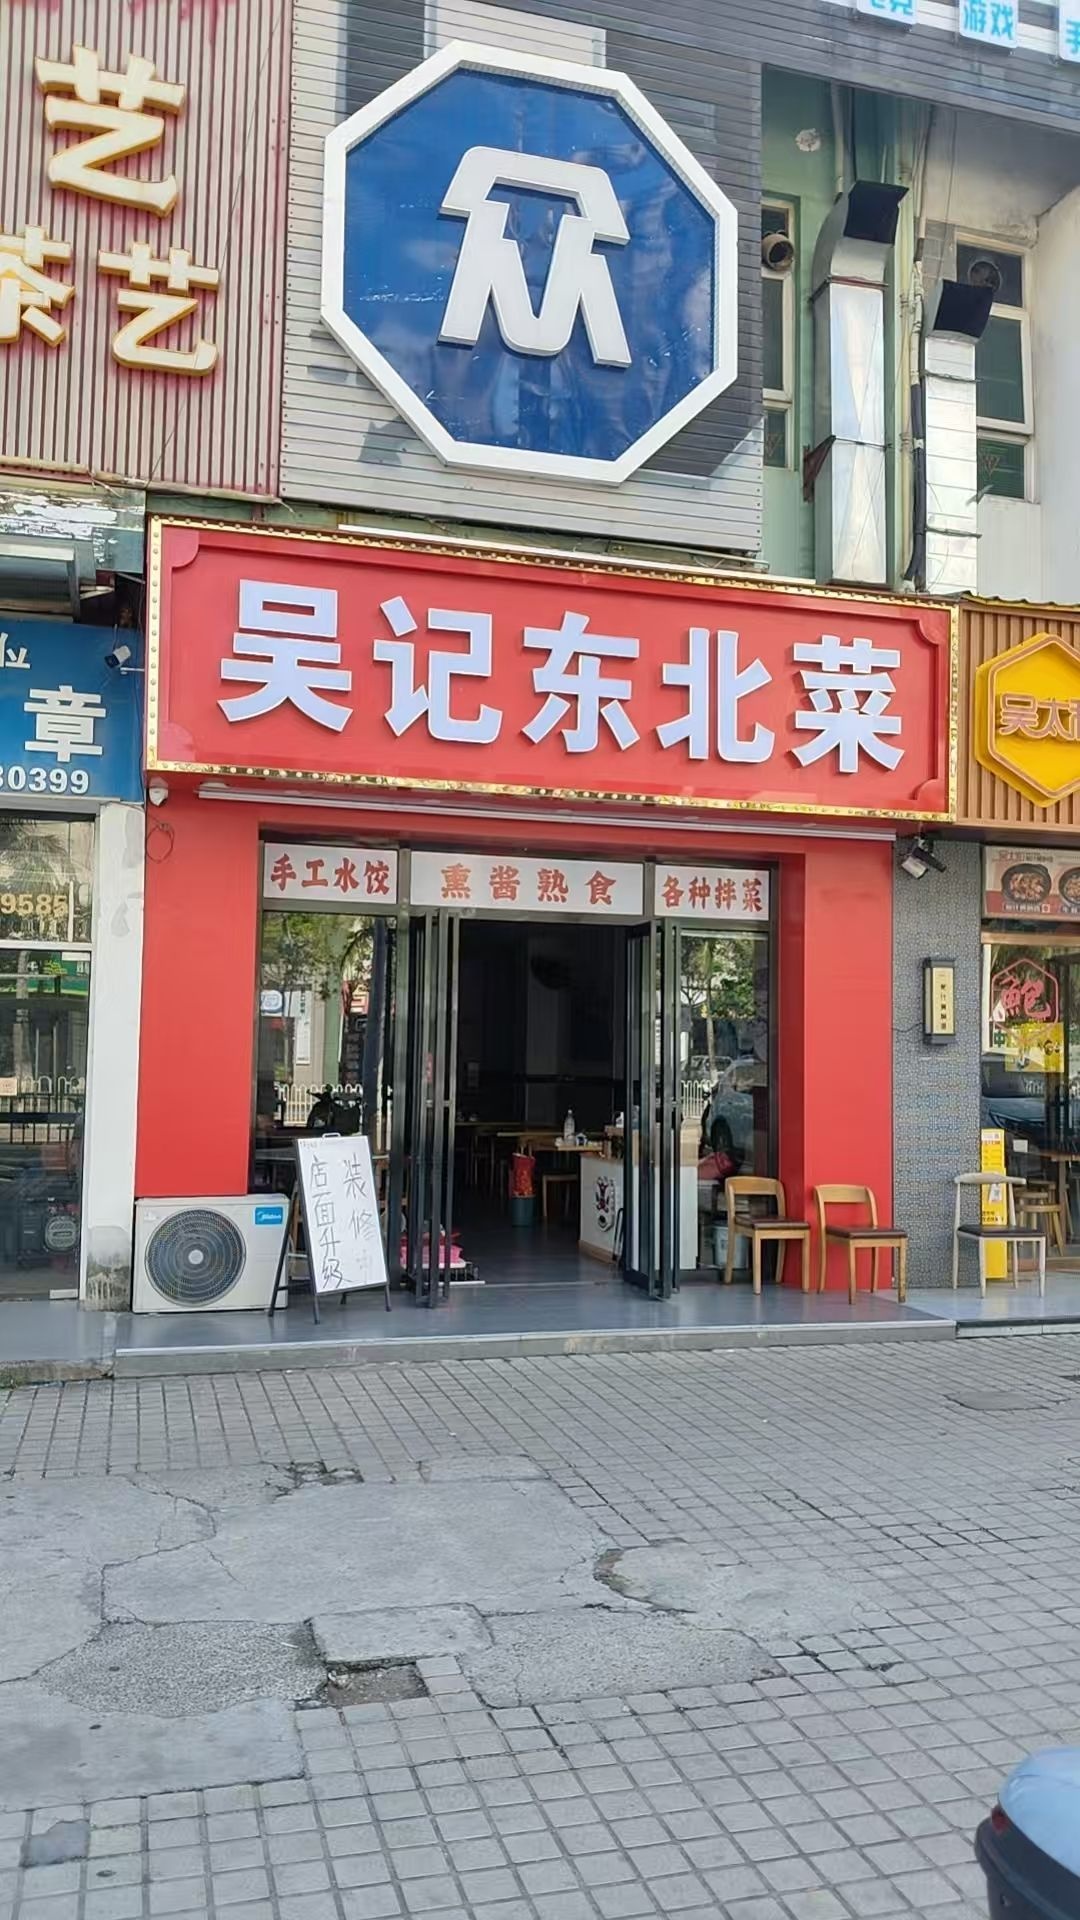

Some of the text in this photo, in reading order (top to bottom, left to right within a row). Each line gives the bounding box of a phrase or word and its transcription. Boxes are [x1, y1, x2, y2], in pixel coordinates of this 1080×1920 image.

[963, 0, 1014, 40] 游戏
[35, 40, 185, 217] 艺
[217, 579, 904, 773] 吴记东北菜
[24, 685, 106, 762] 章
[0, 765, 89, 794] 0399
[270, 853, 390, 895] 手工水饺
[441, 863, 616, 906] 熏酱熟食
[661, 874, 762, 912] 各种拌菜
[310, 1154, 353, 1289] 店面升级
